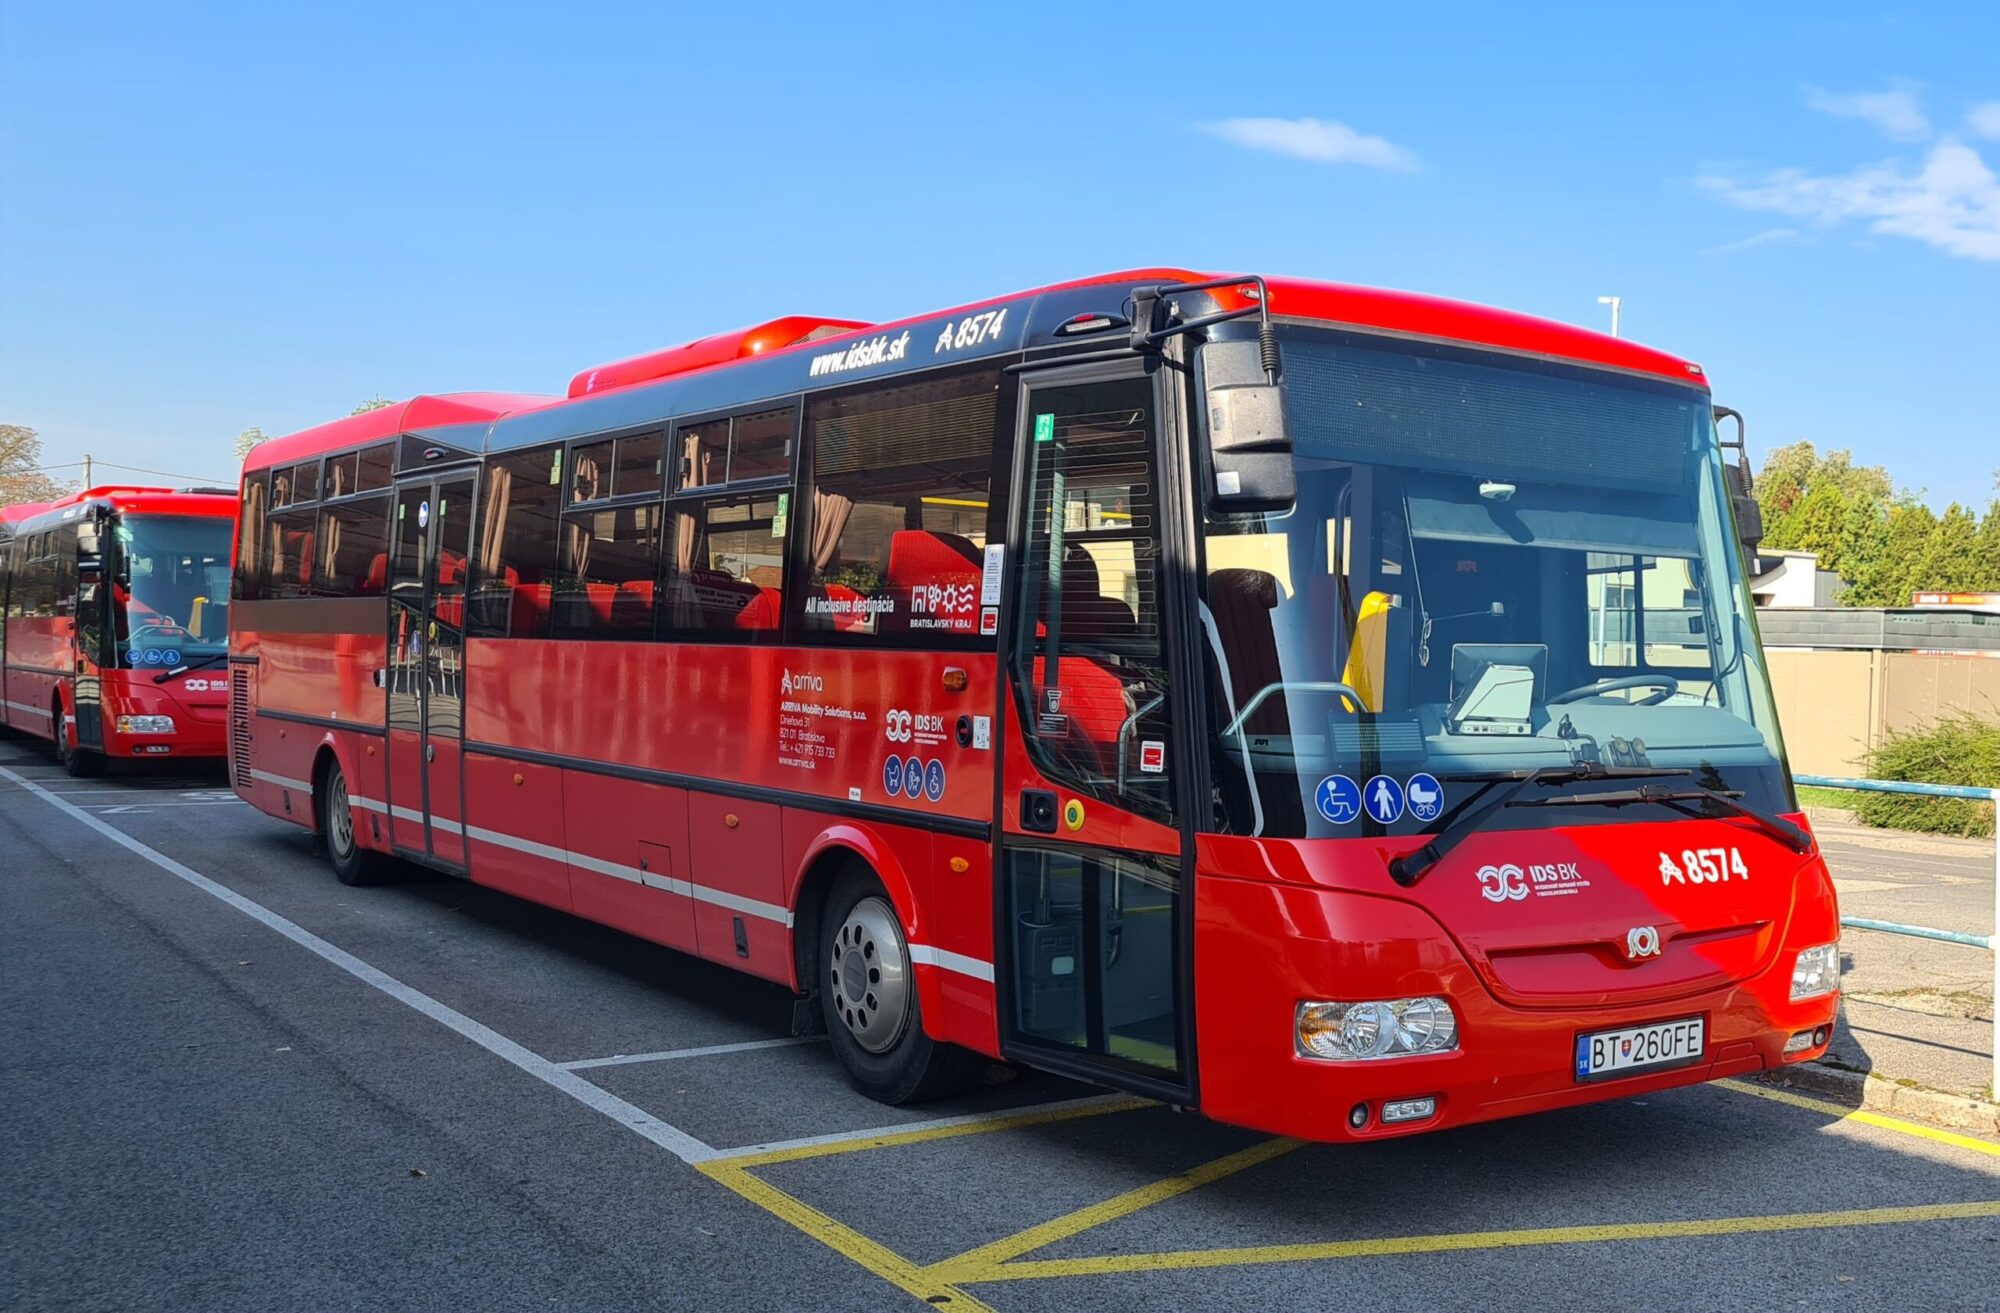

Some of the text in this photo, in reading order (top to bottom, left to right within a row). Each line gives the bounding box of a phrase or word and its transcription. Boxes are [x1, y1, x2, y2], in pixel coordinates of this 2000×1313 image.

[953, 308, 1008, 349] 8574
[809, 330, 911, 377] www.idsbk.sk
[805, 596, 895, 614] All inclusive destinácia
[910, 617, 954, 629] BRATISLAVSKÝ
[954, 619, 972, 629] KRAJ
[793, 671, 823, 692] arriva
[781, 701, 801, 713] ARRIVA
[802, 703, 824, 718] Mobility
[825, 705, 852, 720] Solutions,
[914, 714, 944, 732] IDS BK
[798, 730, 826, 743] Bratislava
[1528, 862, 1582, 883] IDS BK
[1682, 847, 1750, 885] 8574
[1592, 1023, 1700, 1070] BT 260FE
[1579, 1060, 1589, 1070] SK
